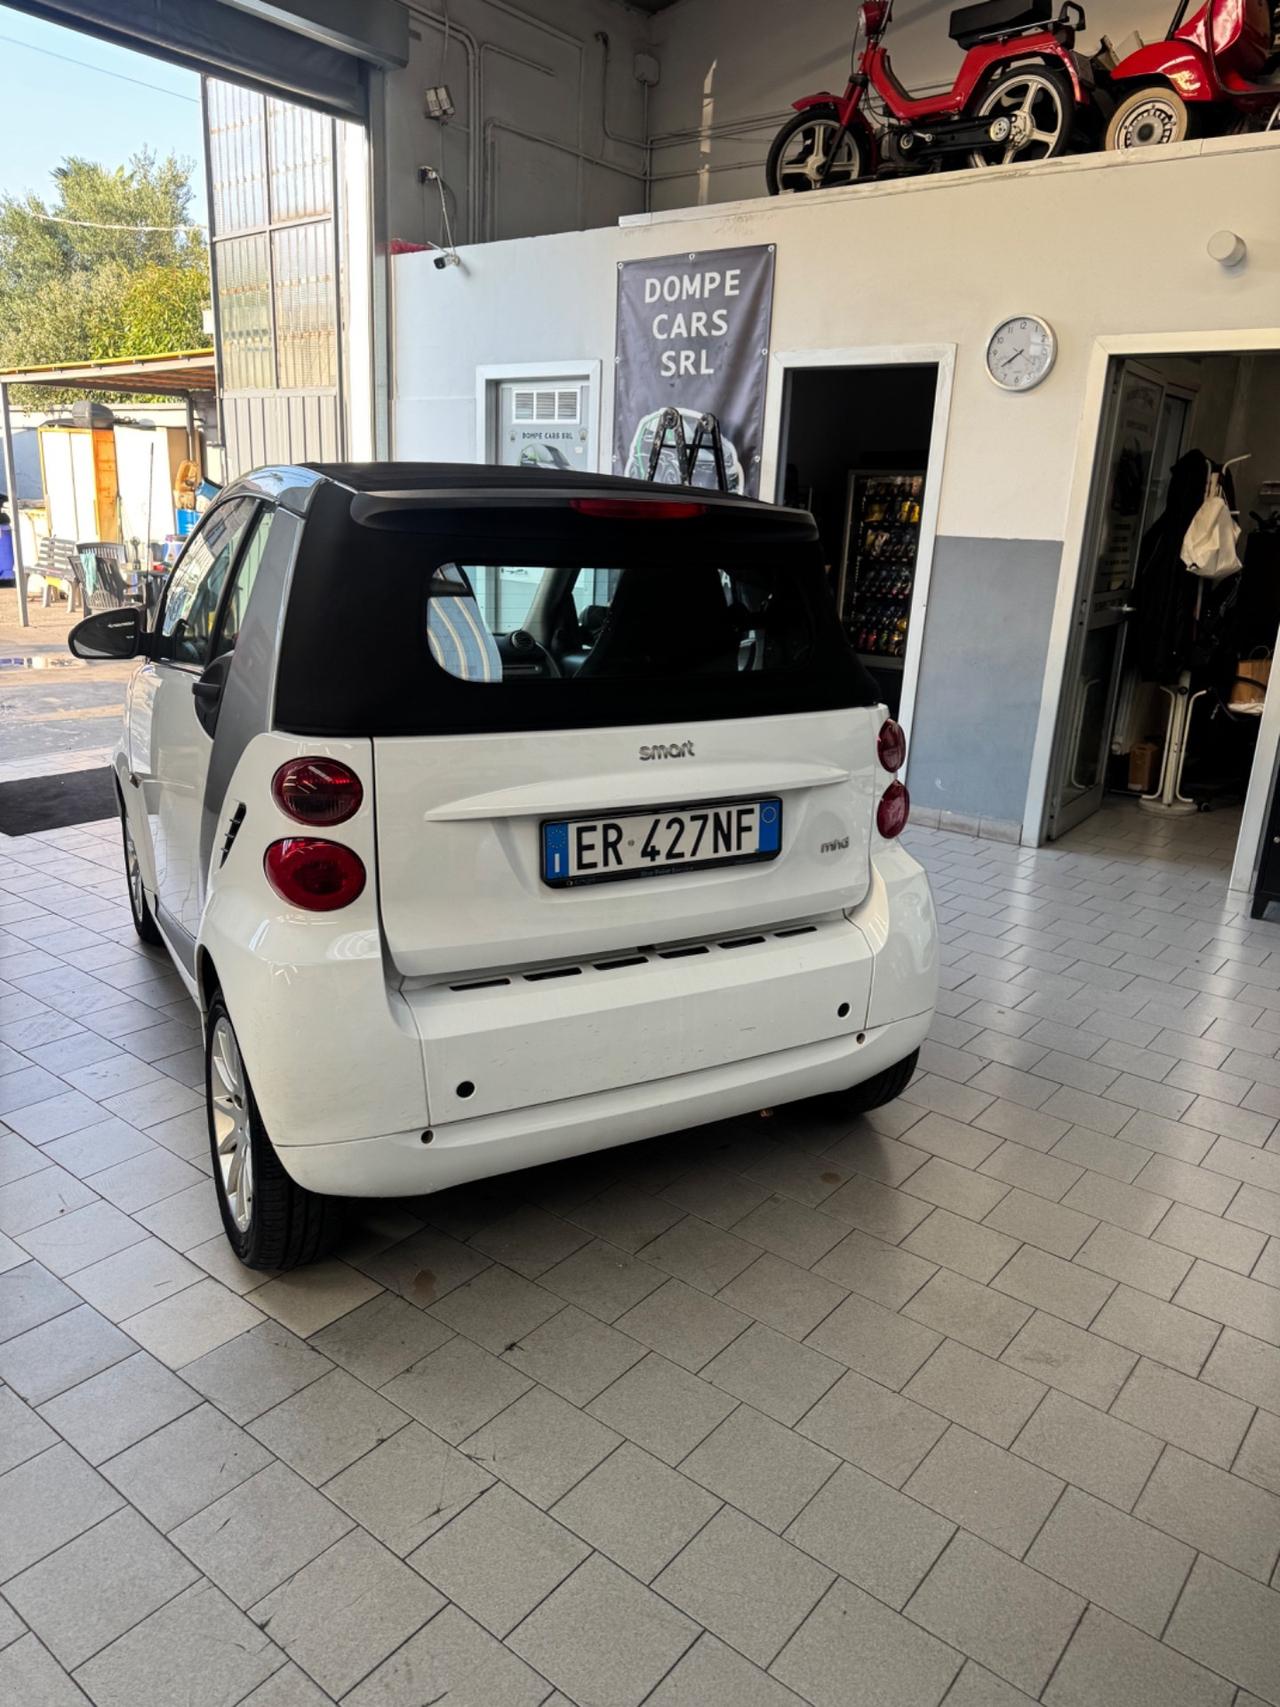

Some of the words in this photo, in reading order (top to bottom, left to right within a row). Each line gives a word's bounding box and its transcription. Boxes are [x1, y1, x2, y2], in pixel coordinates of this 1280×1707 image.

[644, 269, 741, 303] DOMPE
[652, 309, 729, 340] CARS
[1008, 326, 1014, 334] 11
[1020, 321, 1027, 329] 12
[997, 336, 1004, 344] 10
[660, 349, 715, 377] SRL
[522, 432, 543, 440] DOMPE
[639, 740, 695, 761] smart
[554, 853, 560, 873] I
[576, 822, 623, 870] ER
[641, 808, 755, 862] 427NF
